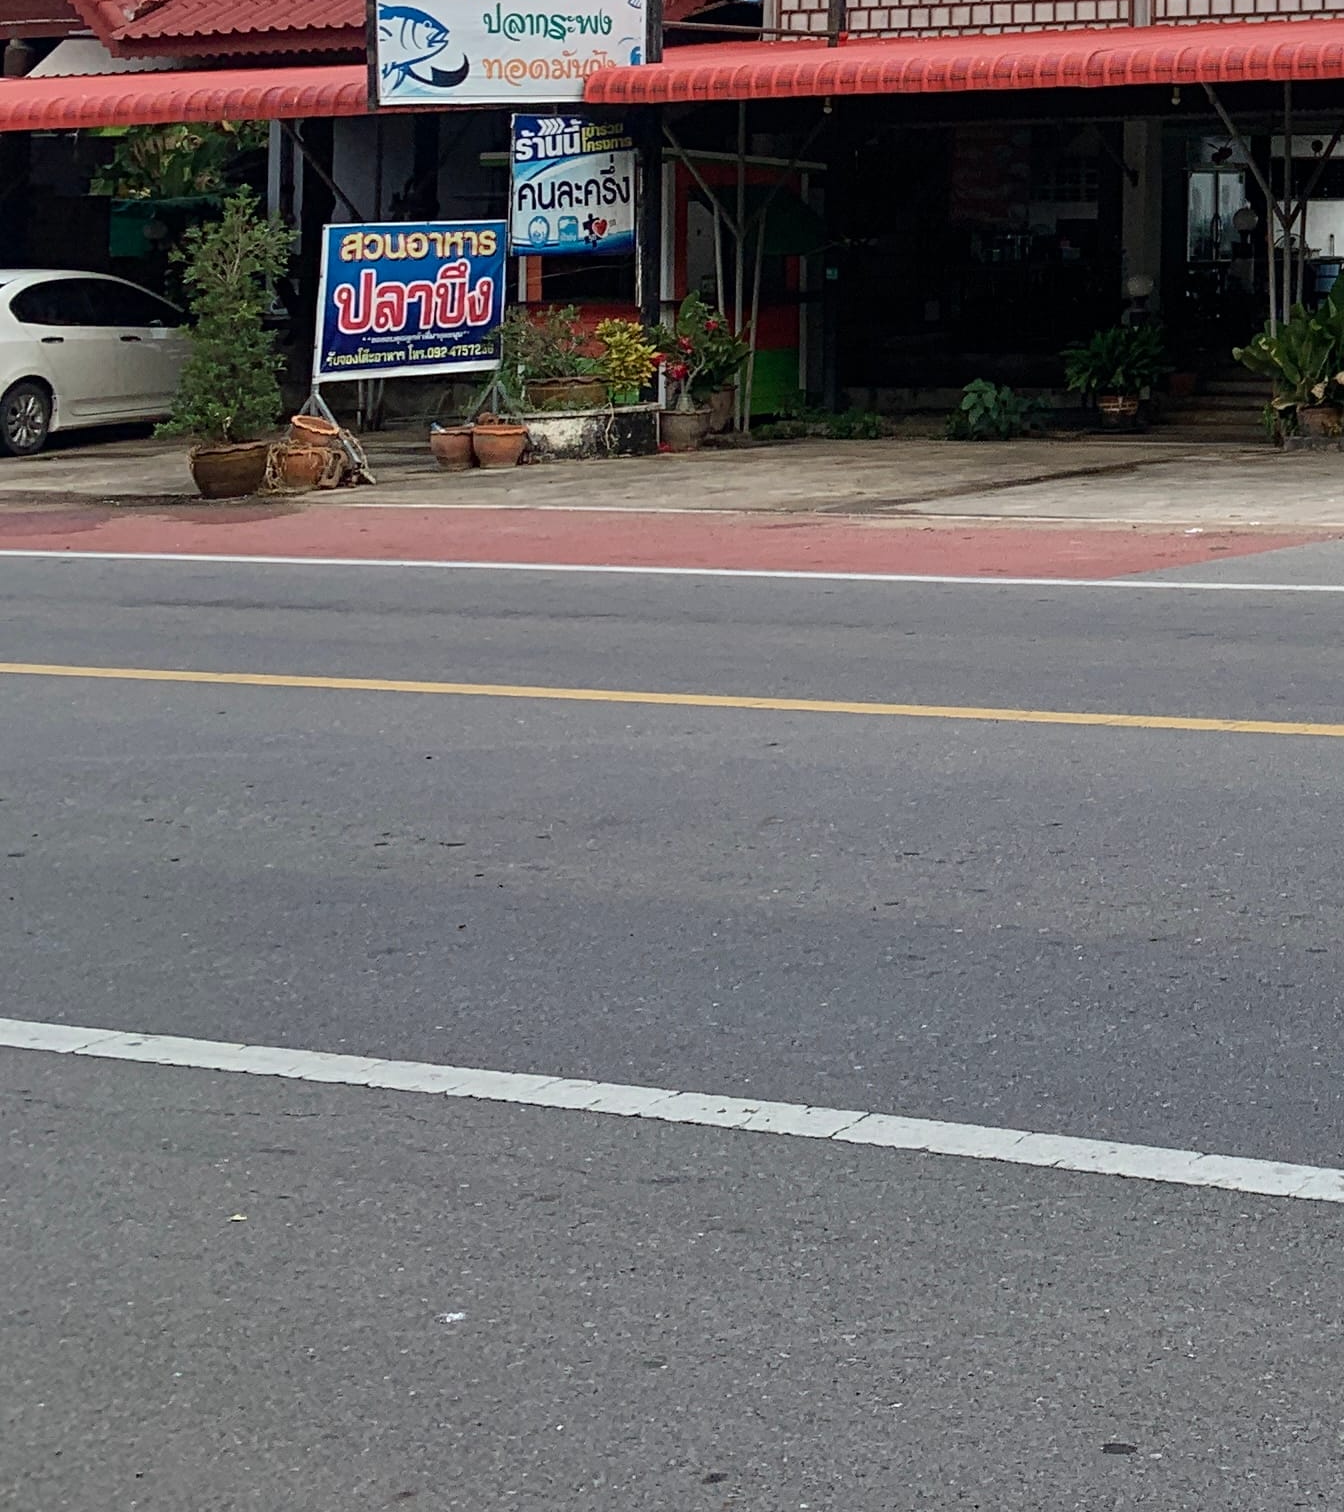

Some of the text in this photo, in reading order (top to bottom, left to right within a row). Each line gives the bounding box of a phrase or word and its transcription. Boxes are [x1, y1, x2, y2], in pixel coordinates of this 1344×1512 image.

[483, 1, 613, 44] ปลากระพง
[515, 118, 583, 162] ร้านนี้
[517, 153, 631, 211] คนละครึ่ง
[340, 229, 497, 262] สวนอาหาร
[334, 258, 494, 335] ปลาบึง
